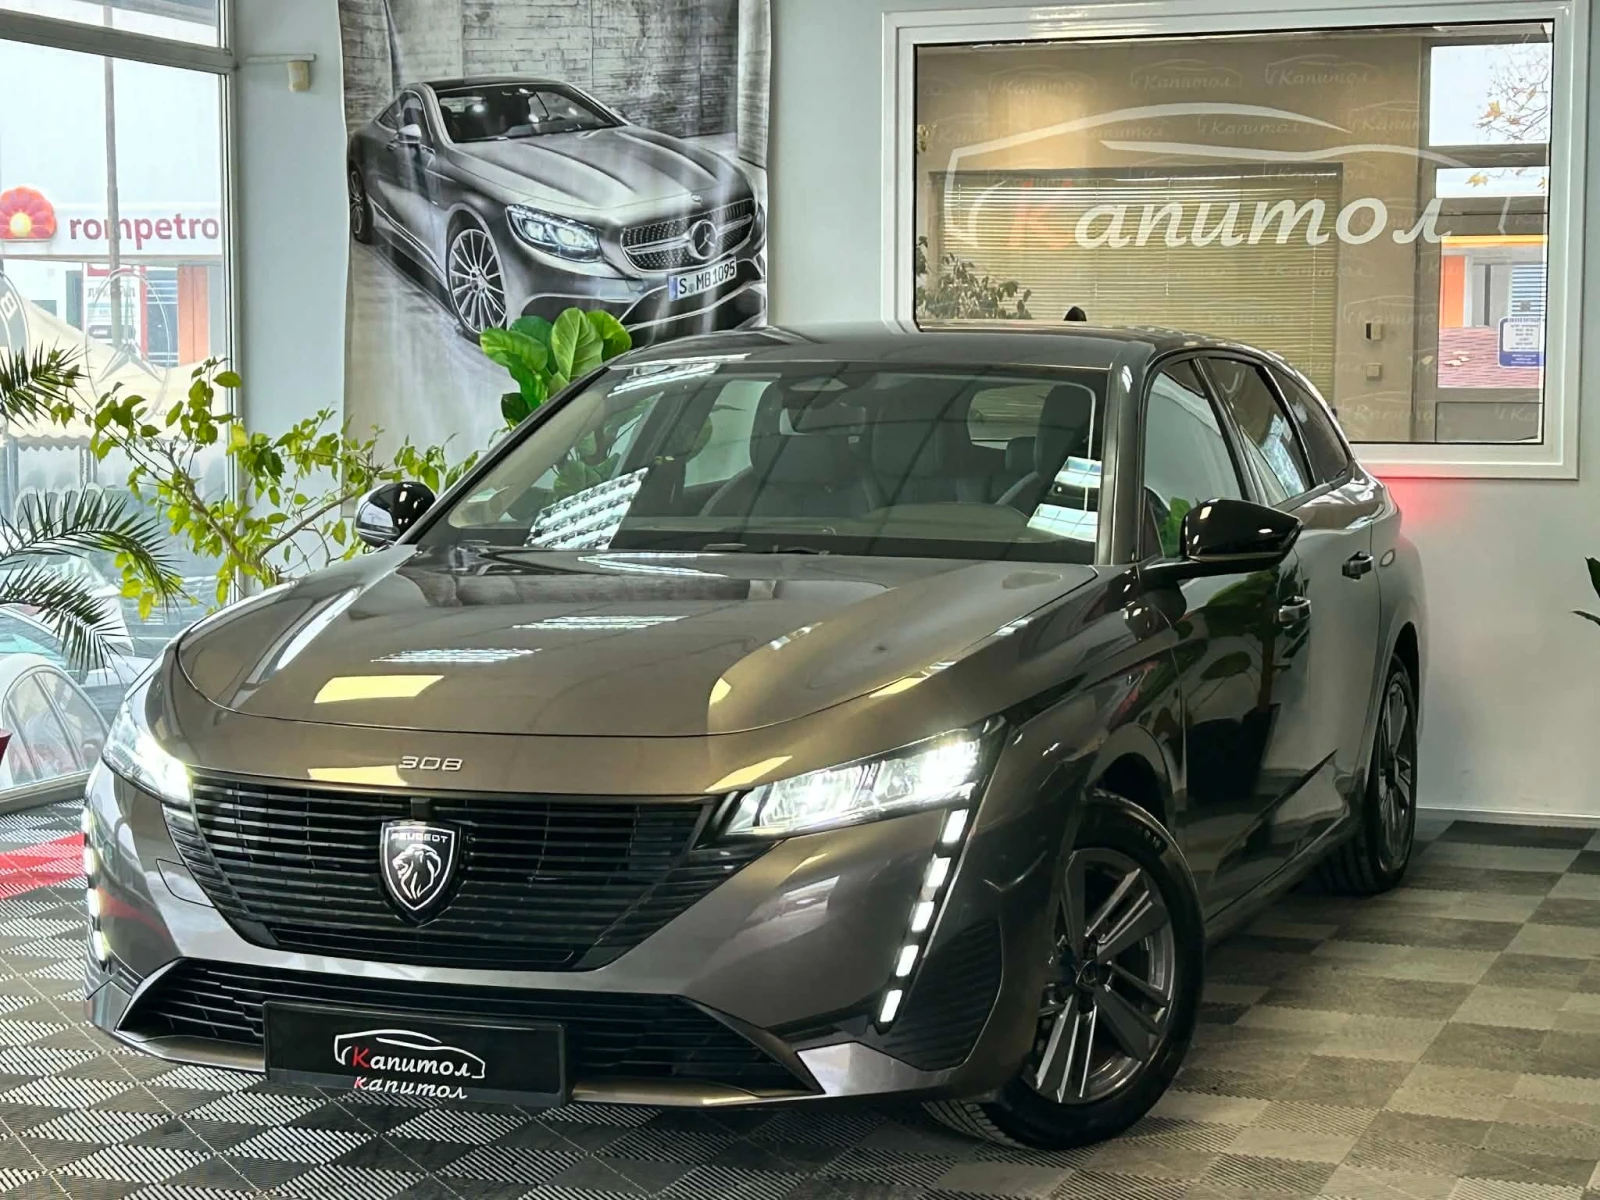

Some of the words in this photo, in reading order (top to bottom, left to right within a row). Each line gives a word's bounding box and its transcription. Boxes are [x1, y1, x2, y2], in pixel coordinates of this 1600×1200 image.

[1007, 176, 1452, 250] Капитол
[679, 277, 688, 295] S
[398, 755, 464, 771] 308
[391, 832, 448, 843] PEUGEOT
[352, 1045, 471, 1077] Капитол
